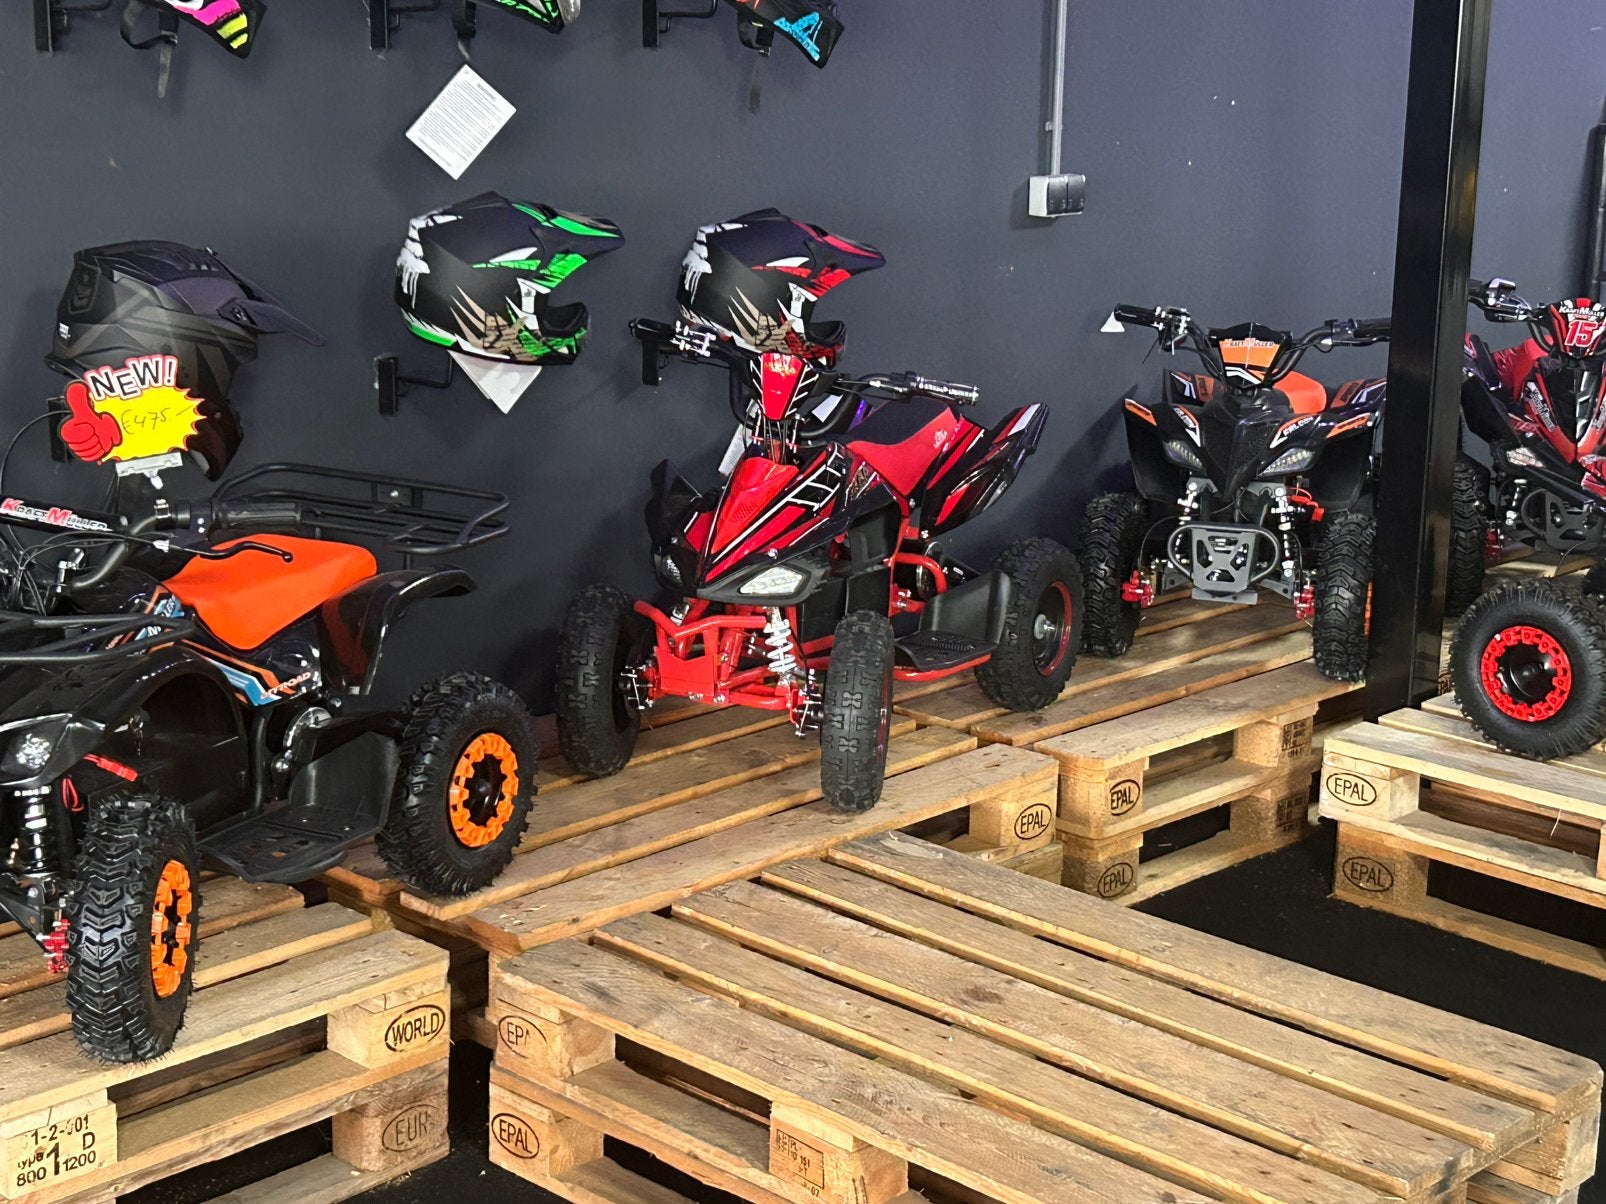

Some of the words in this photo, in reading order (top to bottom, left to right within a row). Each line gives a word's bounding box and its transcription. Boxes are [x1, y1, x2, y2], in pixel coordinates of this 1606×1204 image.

[1564, 319, 1599, 348] 15
[88, 357, 175, 399] NEW!
[1110, 786, 1133, 810] EPAL
[1334, 777, 1368, 802] EPAL
[1020, 810, 1046, 834] EPAL
[1103, 868, 1128, 893] EPAL
[1350, 862, 1385, 887] EPAL
[392, 1012, 440, 1046] WORLD
[82, 1132, 96, 1151] D
[499, 1118, 533, 1154] EPAL
[16, 1167, 47, 1187] 800
[62, 1150, 97, 1171] 1200
[46, 1142, 60, 1176] 1
